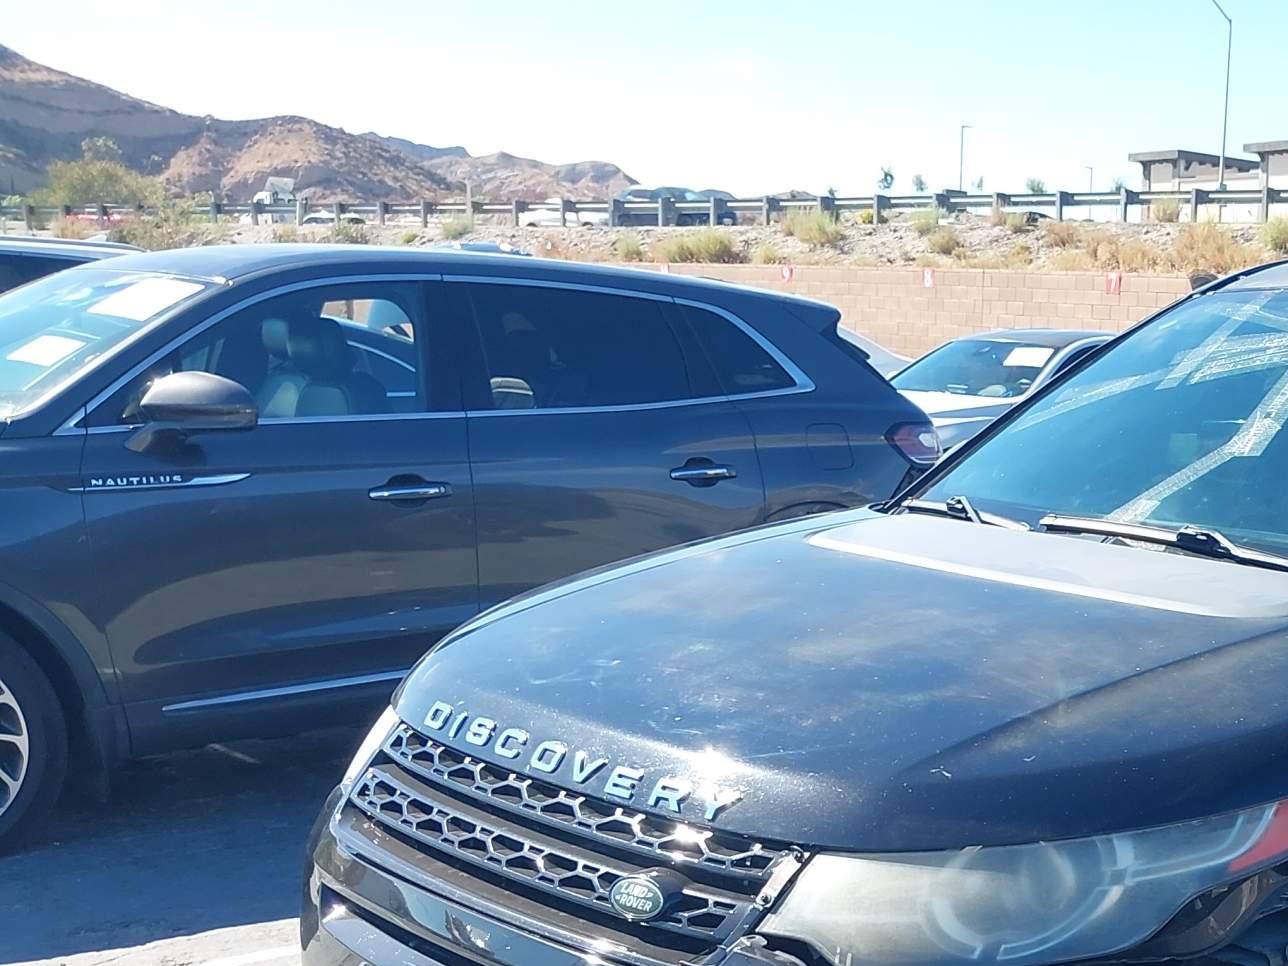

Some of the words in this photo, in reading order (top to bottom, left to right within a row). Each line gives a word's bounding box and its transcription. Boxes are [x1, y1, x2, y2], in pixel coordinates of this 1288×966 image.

[923, 270, 932, 287] 8
[1107, 272, 1118, 294] 7
[91, 475, 183, 487] NAUTILUS
[423, 699, 743, 820] DISCOVERY
[621, 882, 649, 898] LAND
[619, 894, 653, 912] ROVER
